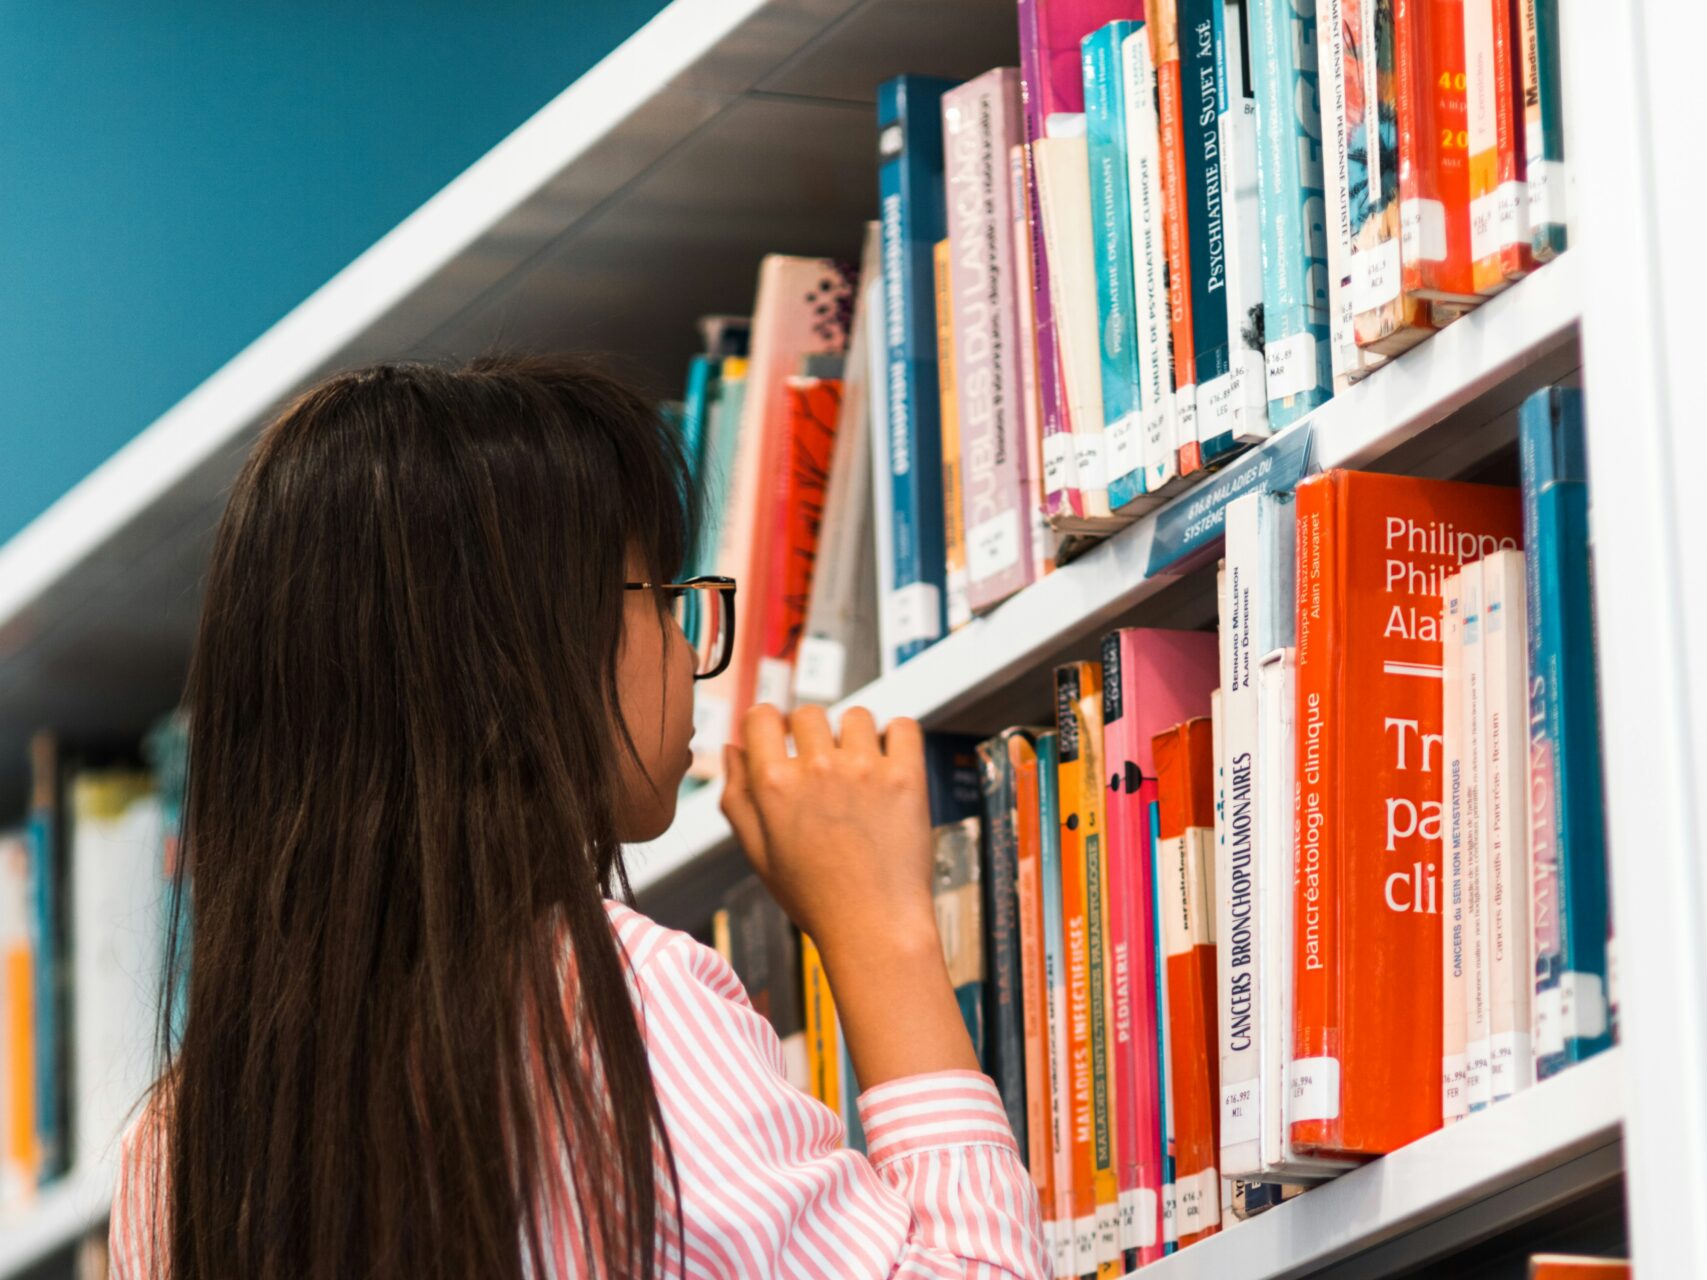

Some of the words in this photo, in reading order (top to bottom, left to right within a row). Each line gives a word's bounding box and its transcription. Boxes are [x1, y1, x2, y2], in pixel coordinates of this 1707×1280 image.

[1195, 19, 1212, 58] ÂGÉ
[1334, 43, 1342, 81] PENSE
[1199, 68, 1216, 127] SUJET
[1335, 86, 1343, 110] UNE
[1526, 35, 1539, 107] Maladies
[1164, 128, 1173, 146] de
[1203, 130, 1218, 161] DU
[1337, 115, 1346, 183] PERSONNE
[952, 102, 985, 294] LANGAGE
[1140, 157, 1150, 224] CLINIQUE
[1166, 150, 1179, 218] cliniques
[1340, 186, 1349, 237] AUTISTE
[1171, 221, 1181, 250] cas
[1206, 166, 1225, 293] PSYCHIATRIE
[1145, 227, 1157, 319] PSYCHIATRIE
[1172, 252, 1181, 267] et
[959, 300, 987, 364] DU
[1106, 265, 1123, 355] PSYCHIATRIE
[1149, 321, 1158, 344] DE
[1213, 468, 1258, 504] MALADIES
[1258, 456, 1273, 478] DU
[1183, 505, 1225, 543] SYSTÈME
[1310, 512, 1320, 579] Sauvanet
[1385, 516, 1517, 563] Philippe
[1299, 515, 1309, 605] Ruszniewski
[1231, 565, 1240, 625] MILLERON
[1241, 586, 1250, 649] DEPIERRE
[1311, 582, 1320, 620] Alain
[1231, 633, 1240, 693] BERNARD
[1299, 607, 1310, 666] Philippe
[1242, 653, 1251, 688] ALAIN
[1305, 692, 1324, 784] clinique
[1385, 717, 1443, 773] Tr
[1385, 796, 1443, 851] pa
[1230, 752, 1252, 968] BRONCHOPULMONAIRES
[1304, 793, 1325, 971] pancréatologie
[1384, 862, 1443, 914] cli
[1452, 852, 1461, 876] NON
[1087, 841, 1102, 968] PARASITOLOGIE
[1453, 880, 1462, 906] SEIN
[1454, 908, 1462, 922] du
[1453, 924, 1463, 978] CANCERS
[1494, 907, 1503, 962] Cancers
[1069, 915, 1088, 1041] INFECTIEUSES
[1114, 941, 1131, 1043] PÉDIATRIE
[1091, 971, 1106, 1077] INFECTIEUSES
[1230, 971, 1252, 1053] CANCERS
[1074, 1048, 1091, 1143] MALADIES
[1094, 1081, 1108, 1162] MALADIES
[1226, 1090, 1250, 1106] 616.992
[1232, 1107, 1243, 1118] MIL
[1447, 1087, 1459, 1099] FER
